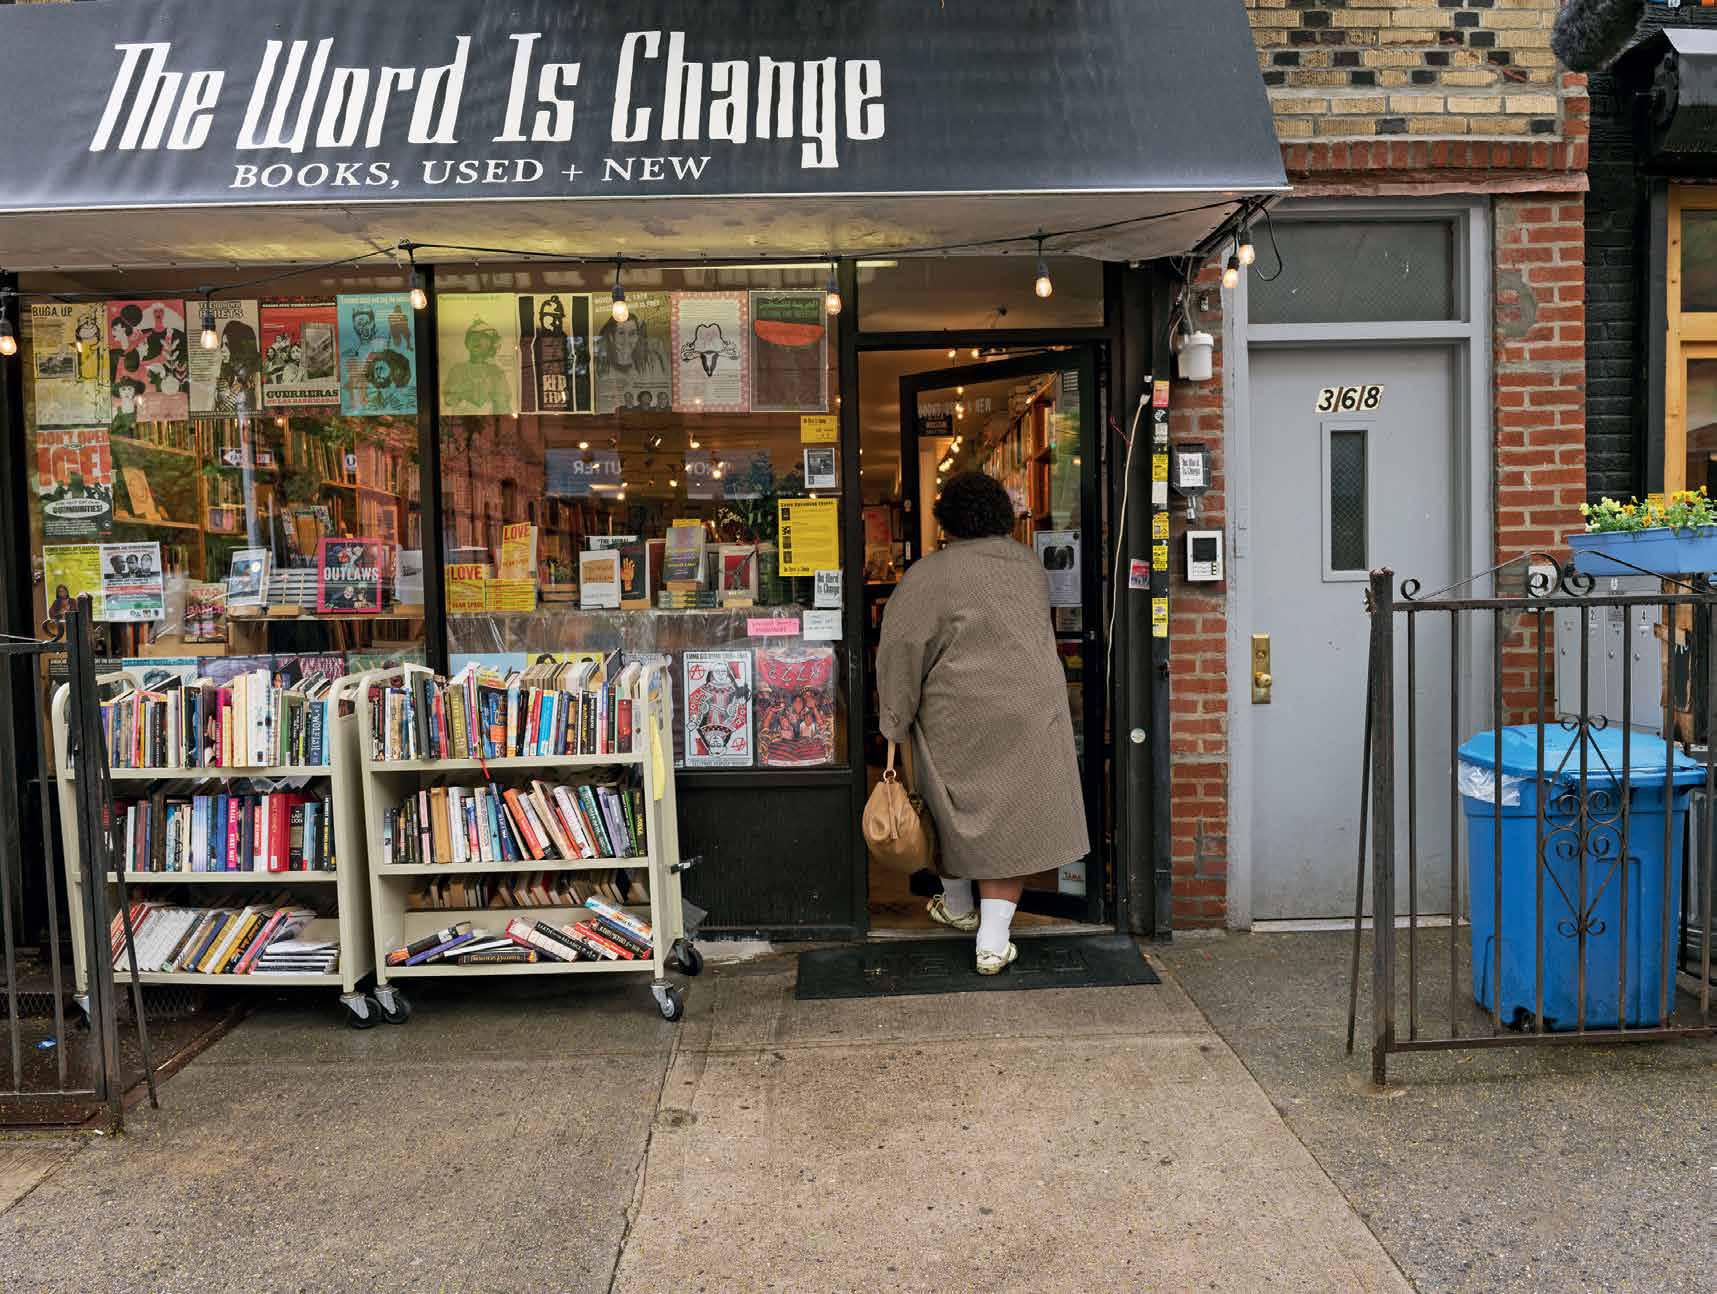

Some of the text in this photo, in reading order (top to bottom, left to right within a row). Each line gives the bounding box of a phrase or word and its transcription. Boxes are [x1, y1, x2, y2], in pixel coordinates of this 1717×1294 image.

[89, 31, 884, 169] The Word Is Change
[232, 156, 712, 190] BOOKS, USED + NEW
[504, 525, 531, 541] LOVE
[323, 566, 379, 582] OUTLAWS
[450, 565, 483, 581] LOVE
